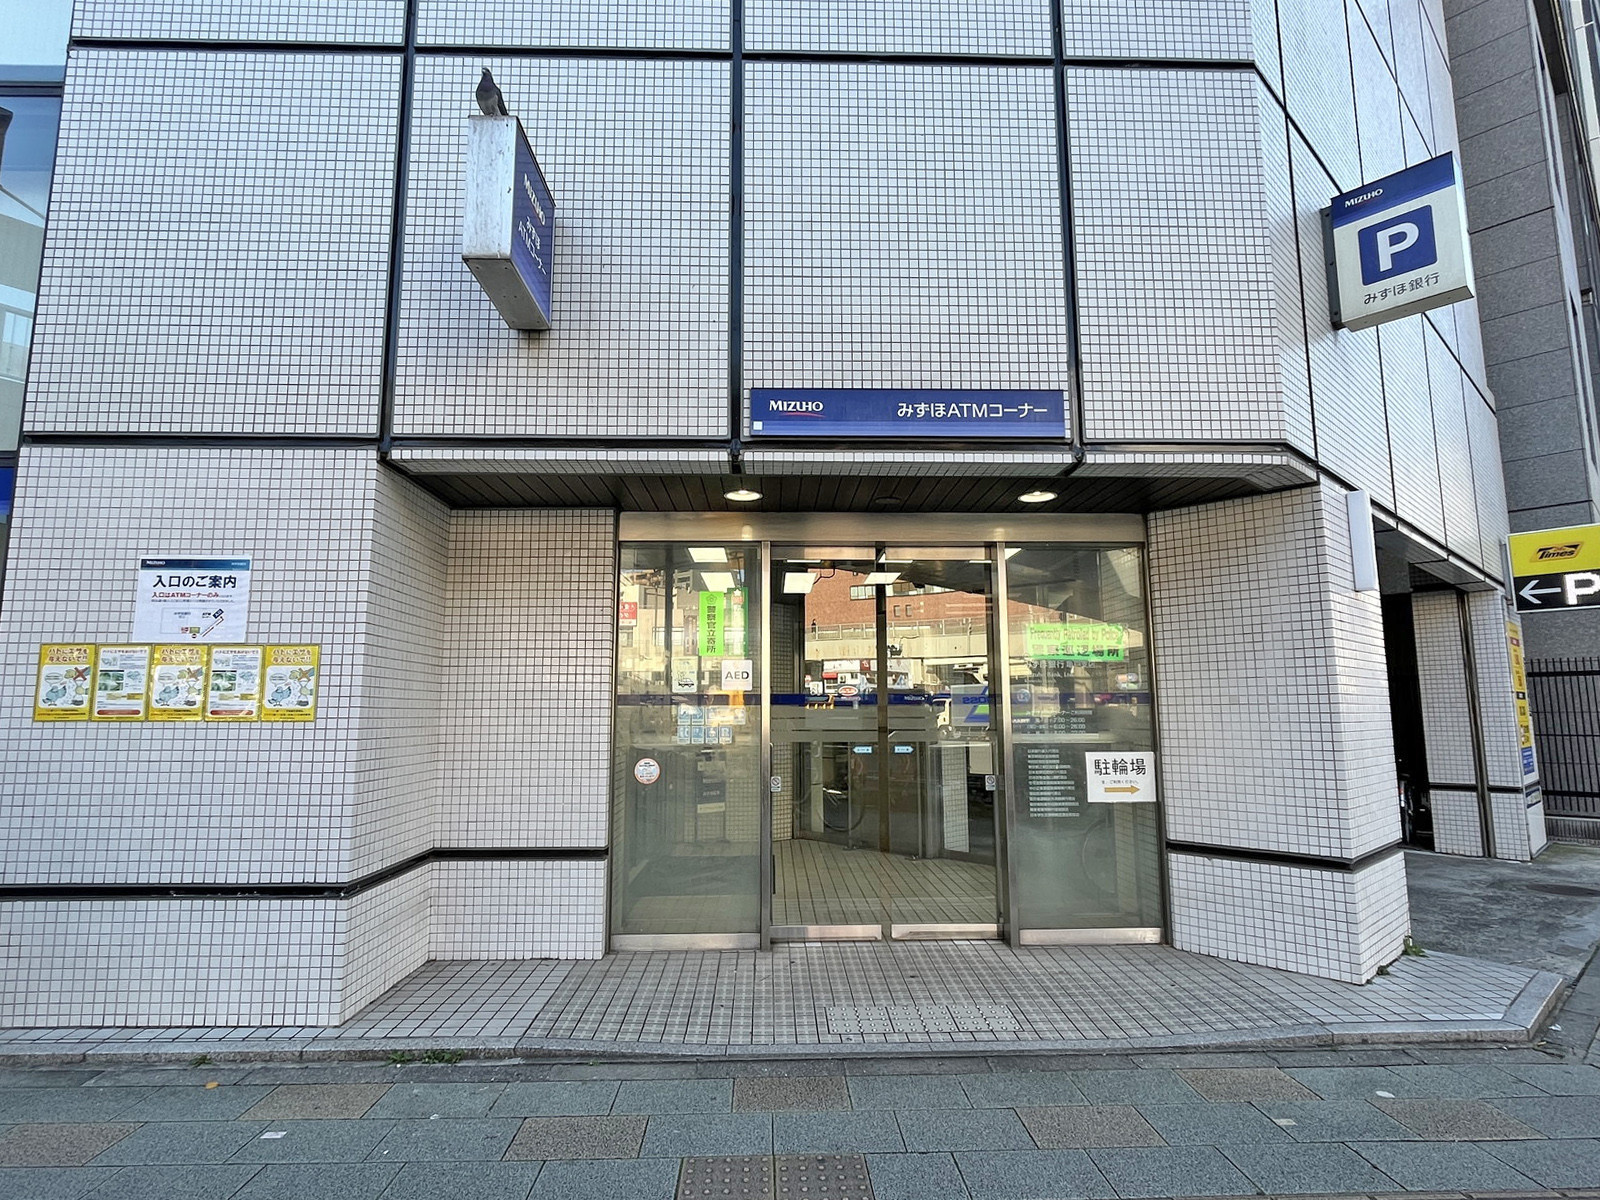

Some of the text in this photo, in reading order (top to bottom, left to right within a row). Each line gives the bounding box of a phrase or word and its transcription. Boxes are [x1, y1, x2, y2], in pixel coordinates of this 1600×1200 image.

[523, 172, 546, 226] MIZUHO
[1344, 188, 1384, 208] MIZUHO
[1376, 221, 1420, 273] P
[1363, 272, 1440, 305] みずほ銀行
[768, 399, 824, 413] MIZUHO
[896, 402, 1049, 419] みずほATMコーナー
[1537, 549, 1575, 560] Times
[152, 575, 237, 588] 入口のご案内
[1563, 572, 1600, 605] P
[706, 605, 717, 654] 警察官立寄所
[724, 670, 751, 680] AED
[1094, 758, 1147, 776] 駐輪場
